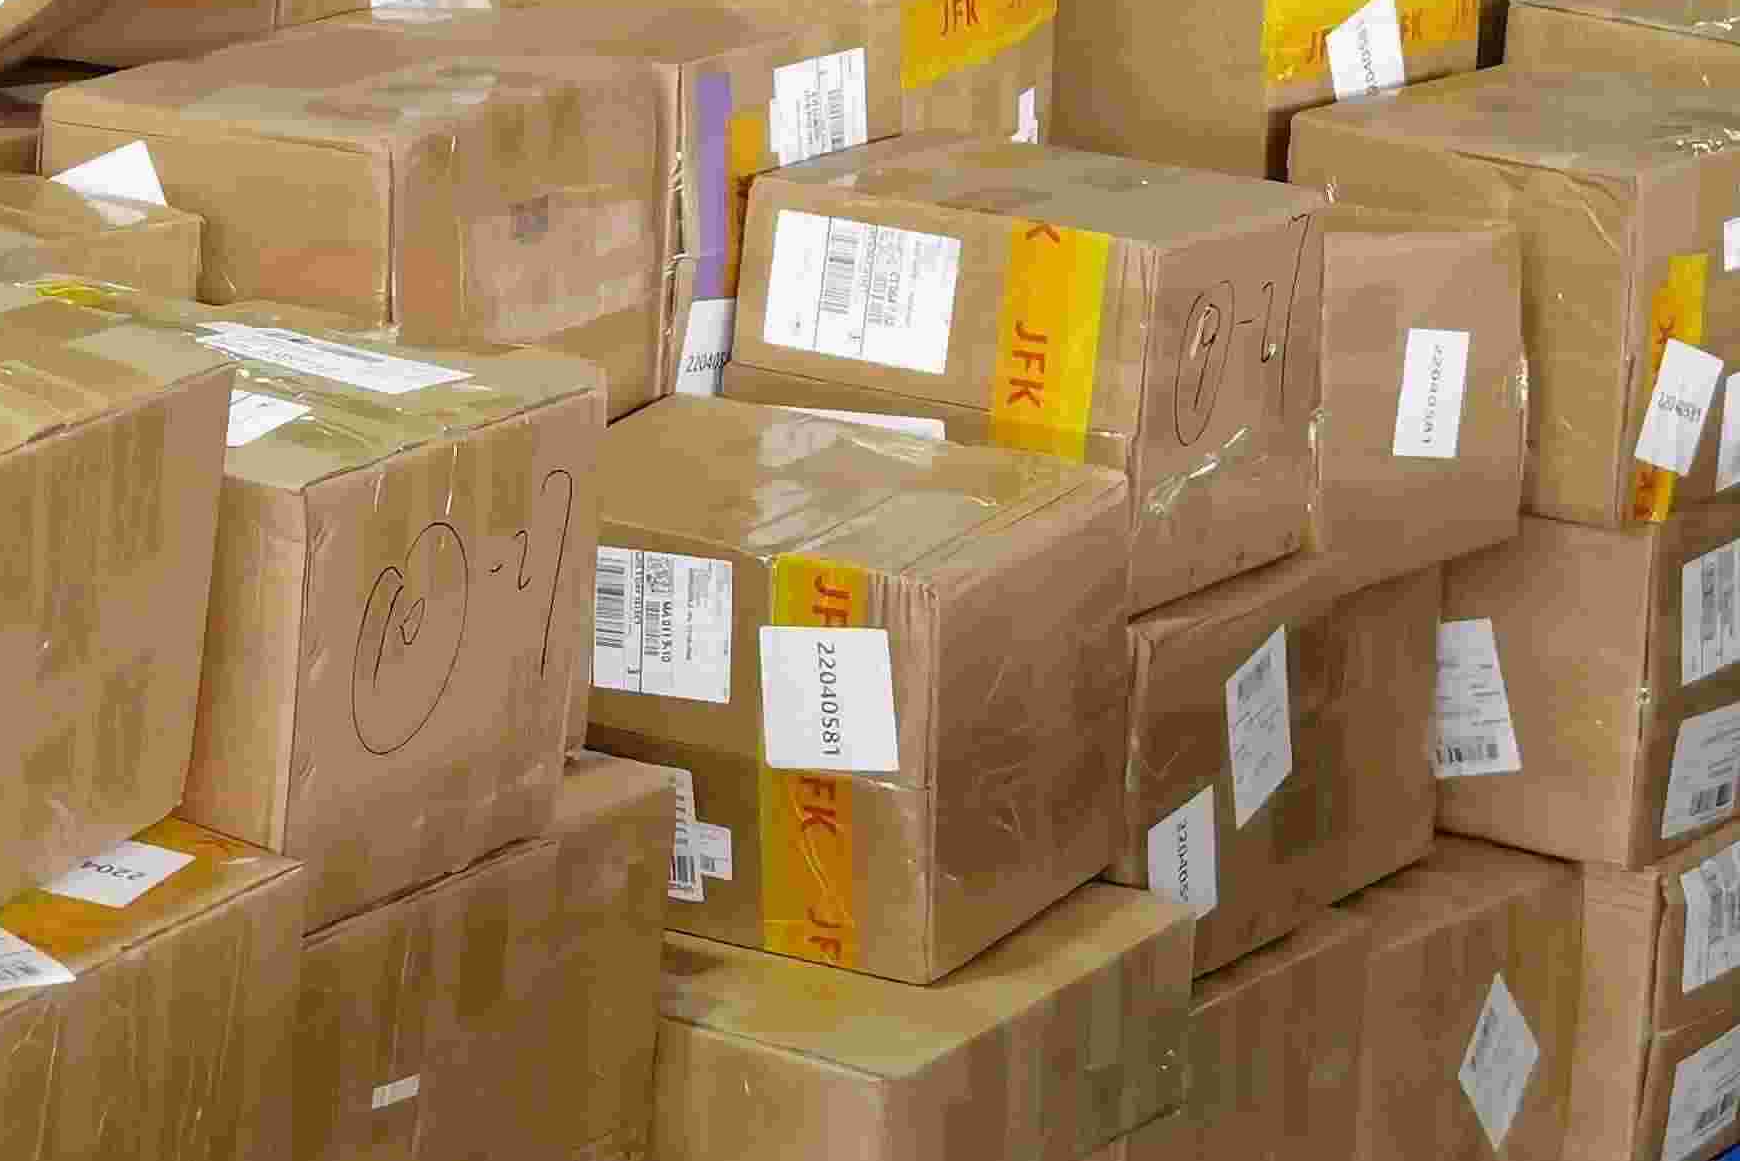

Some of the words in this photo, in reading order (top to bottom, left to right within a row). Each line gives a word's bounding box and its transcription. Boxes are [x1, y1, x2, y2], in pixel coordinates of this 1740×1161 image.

[1305, 28, 1326, 64] JF
[1006, 320, 1049, 409] JFK
[813, 573, 854, 627] JF
[814, 641, 842, 758] 22040581
[799, 776, 838, 838] FK
[80, 858, 148, 882] 2204
[807, 905, 843, 964] JF
